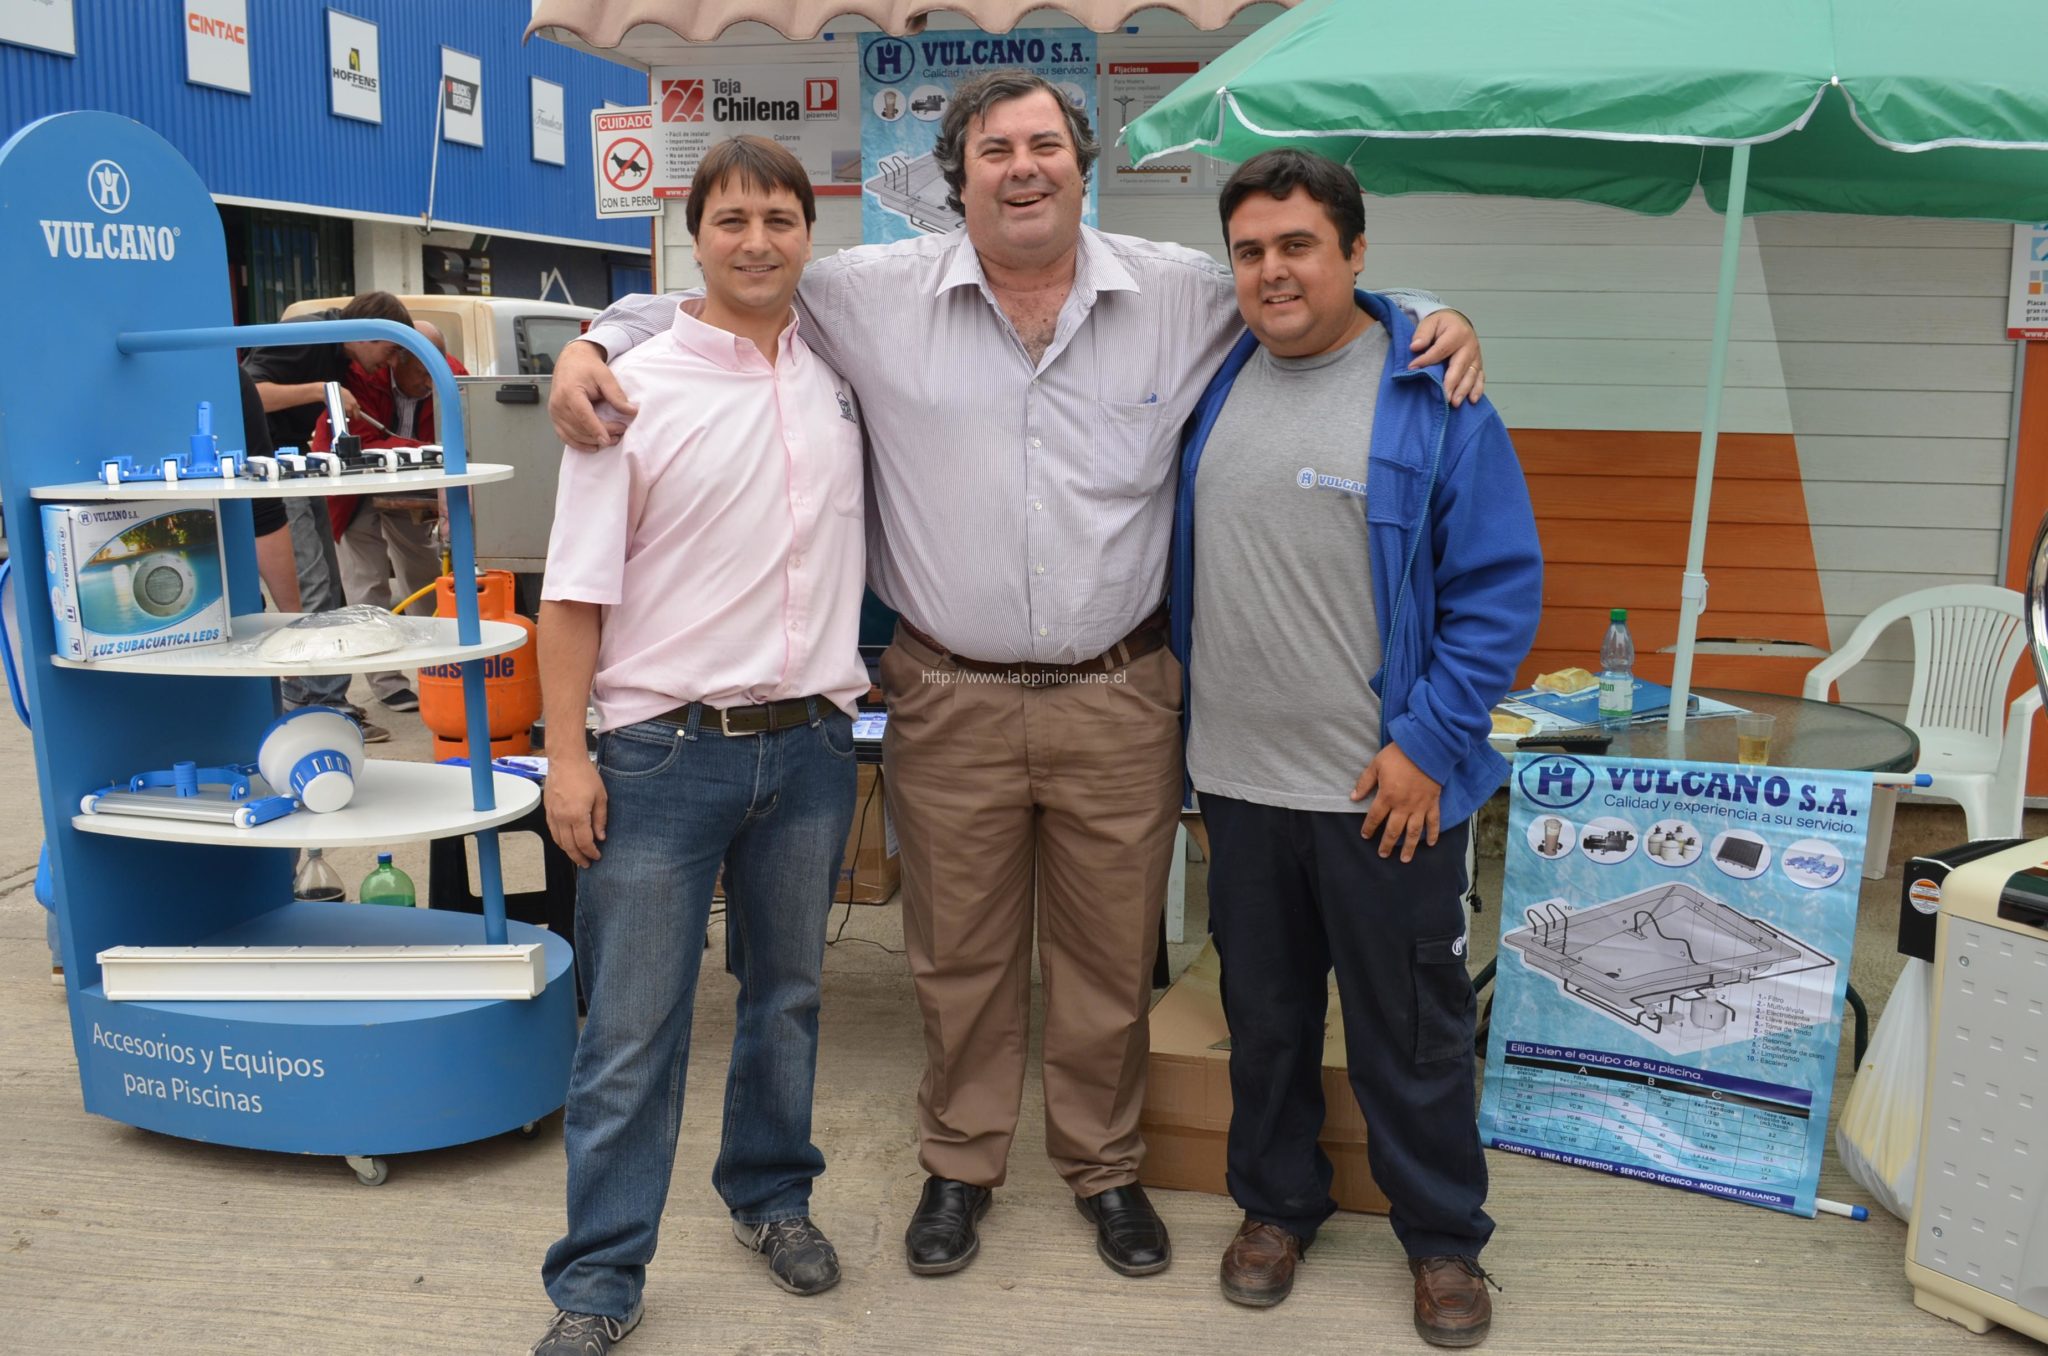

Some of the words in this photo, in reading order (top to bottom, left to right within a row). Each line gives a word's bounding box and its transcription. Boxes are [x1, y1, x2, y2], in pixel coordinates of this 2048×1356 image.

[188, 12, 245, 45] CINTAC
[921, 38, 1045, 66] VULCANO
[1051, 42, 1090, 63] S.A.
[332, 67, 377, 89] HOFFENS
[712, 78, 741, 95] Teja
[712, 97, 800, 122] Chilena
[599, 115, 652, 130] CUIDADO
[602, 198, 618, 208] CON
[620, 197, 630, 207] EL
[632, 196, 658, 206] PERRO
[1318, 474, 1367, 494] VULCAN
[92, 510, 128, 522] VULCANO
[92, 643, 115, 657] LUZ
[116, 632, 191, 654] SUBACUATICA
[193, 629, 220, 643] LEDS
[1606, 767, 1790, 807] VULCANO
[1798, 784, 1858, 816] S.A.
[1604, 794, 1658, 809] Calidad
[1661, 801, 1671, 811] y
[1674, 801, 1757, 822] experiencia
[1761, 813, 1771, 823] a
[1774, 815, 1792, 826] su
[1796, 817, 1857, 834] servicio.
[93, 1022, 196, 1066] Accesorios
[200, 1048, 214, 1074] y
[220, 1045, 326, 1082] Equipos
[1536, 1047, 1562, 1057] bien
[1565, 1050, 1576, 1058] el
[1578, 1052, 1621, 1065] equipo
[1623, 1058, 1641, 1068] de
[1643, 1061, 1656, 1071] su
[1658, 1064, 1704, 1081] piscina.
[1578, 1066, 1588, 1075] A
[1648, 1077, 1655, 1086] B
[123, 1072, 167, 1099] para
[172, 1078, 263, 1114] Piscinas
[1711, 1090, 1722, 1100] C
[1498, 1143, 1537, 1157] COMPLETA
[1540, 1152, 1561, 1162] LINEA
[1562, 1155, 1572, 1164] DE
[1574, 1158, 1614, 1172] REPUESTOS
[1620, 1167, 1655, 1180] SERVICIO
[1657, 1173, 1693, 1187] TÉCNICO
[1700, 1183, 1738, 1195] MOTORES
[1739, 1190, 1782, 1203] ITALIANOS
